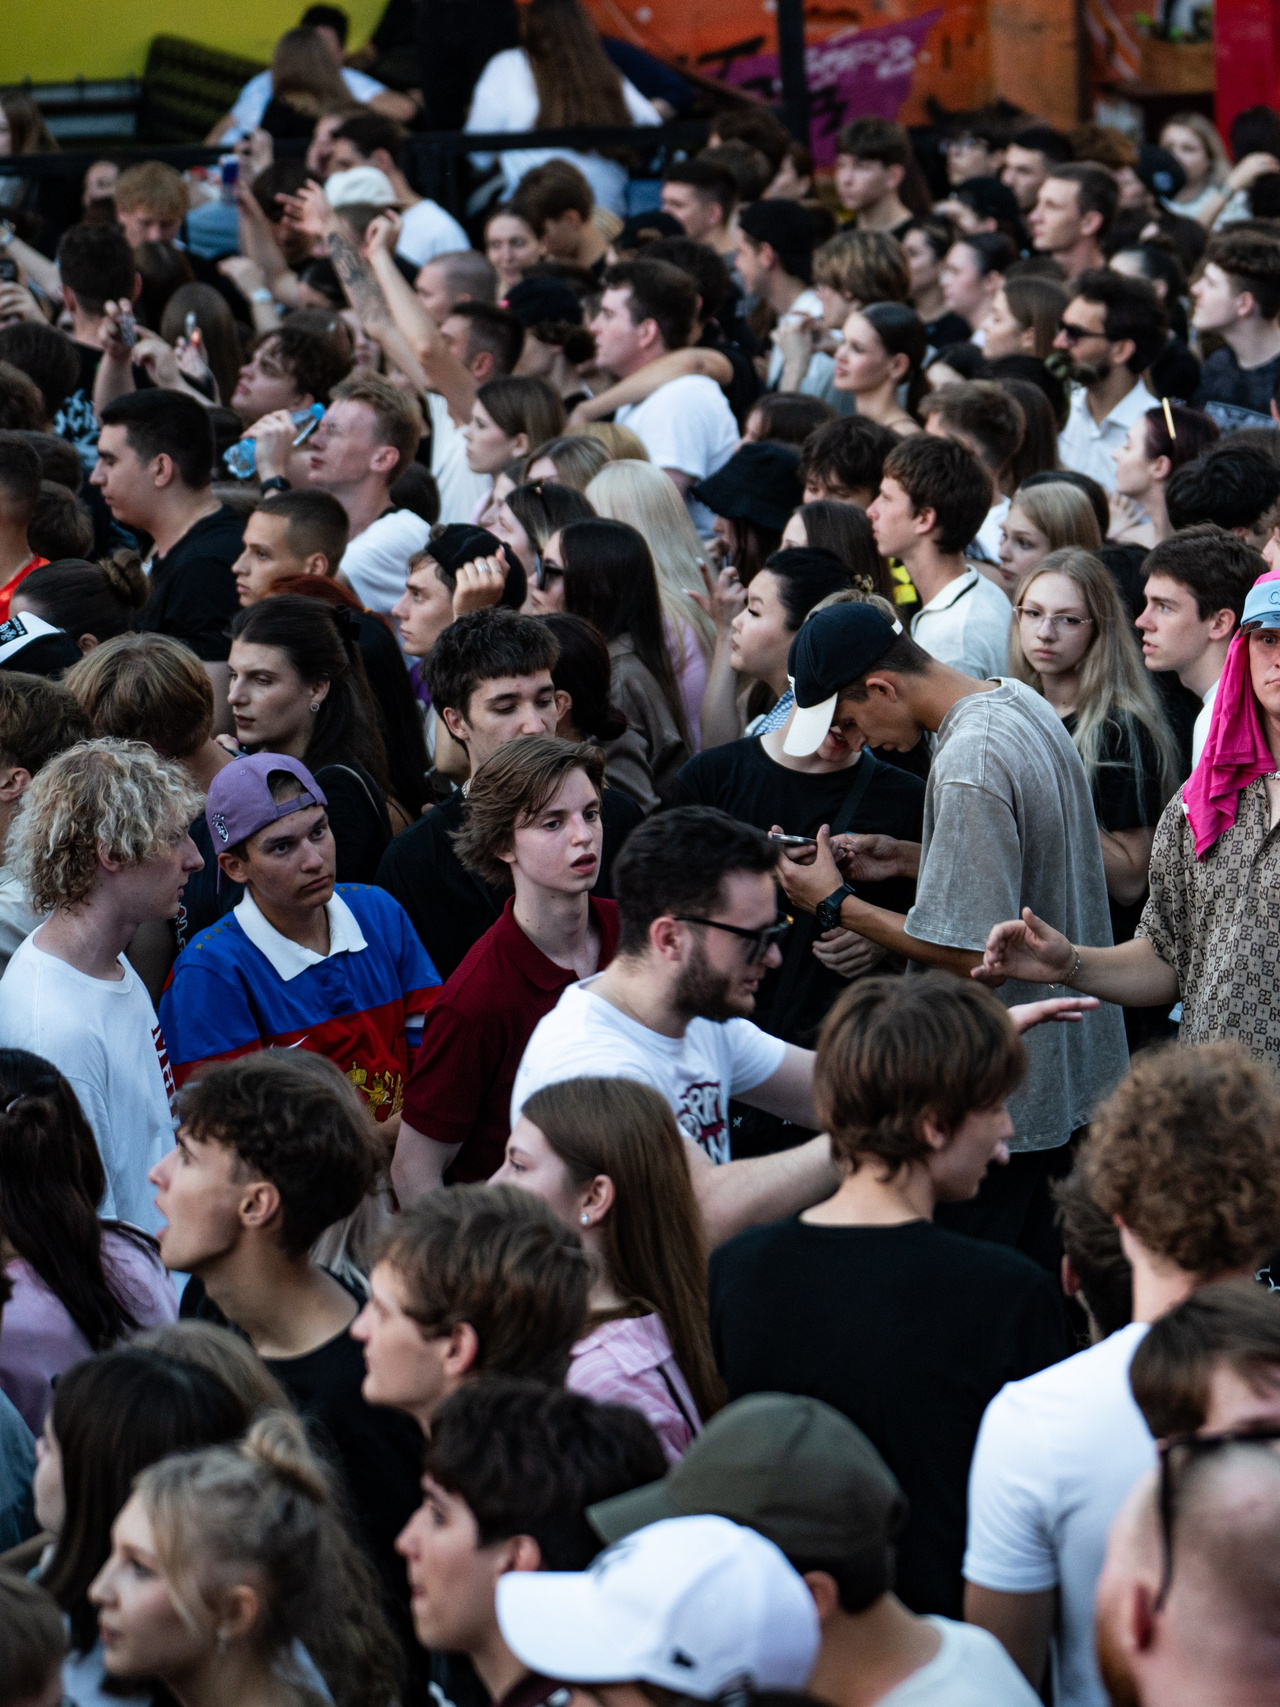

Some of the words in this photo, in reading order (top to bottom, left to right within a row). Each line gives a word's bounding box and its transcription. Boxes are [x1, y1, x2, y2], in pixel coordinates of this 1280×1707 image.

[1236, 814, 1247, 827] 69
[1254, 811, 1264, 826] 69
[1222, 829, 1234, 842] 69
[1245, 826, 1254, 840] 69
[1231, 840, 1243, 855] 69
[1216, 856, 1230, 870] 69
[1240, 855, 1252, 868] 69
[1264, 858, 1278, 871] 69
[1151, 871, 1165, 886] 69
[1226, 868, 1239, 884] 69
[1252, 868, 1262, 883] 69
[1213, 884, 1226, 899] 69
[1225, 898, 1236, 914] 69
[1268, 903, 1279, 919] 69
[1255, 914, 1269, 930] 69
[1218, 928, 1230, 942] 69
[1240, 924, 1253, 941] 69
[1266, 931, 1279, 948] 69
[1250, 942, 1265, 959] 69
[1193, 962, 1204, 978] 69
[1262, 960, 1275, 977] 69
[1187, 979, 1198, 995] 69
[1246, 972, 1260, 987] 69
[1208, 984, 1218, 1000] 69
[1231, 982, 1245, 1000] 69
[1258, 988, 1272, 1006] 69
[1242, 1001, 1257, 1017] 69
[1208, 1014, 1218, 1030] 69
[1254, 1018, 1268, 1035] 69
[1239, 1030, 1253, 1046] 69
[1265, 1036, 1280, 1052] 69
